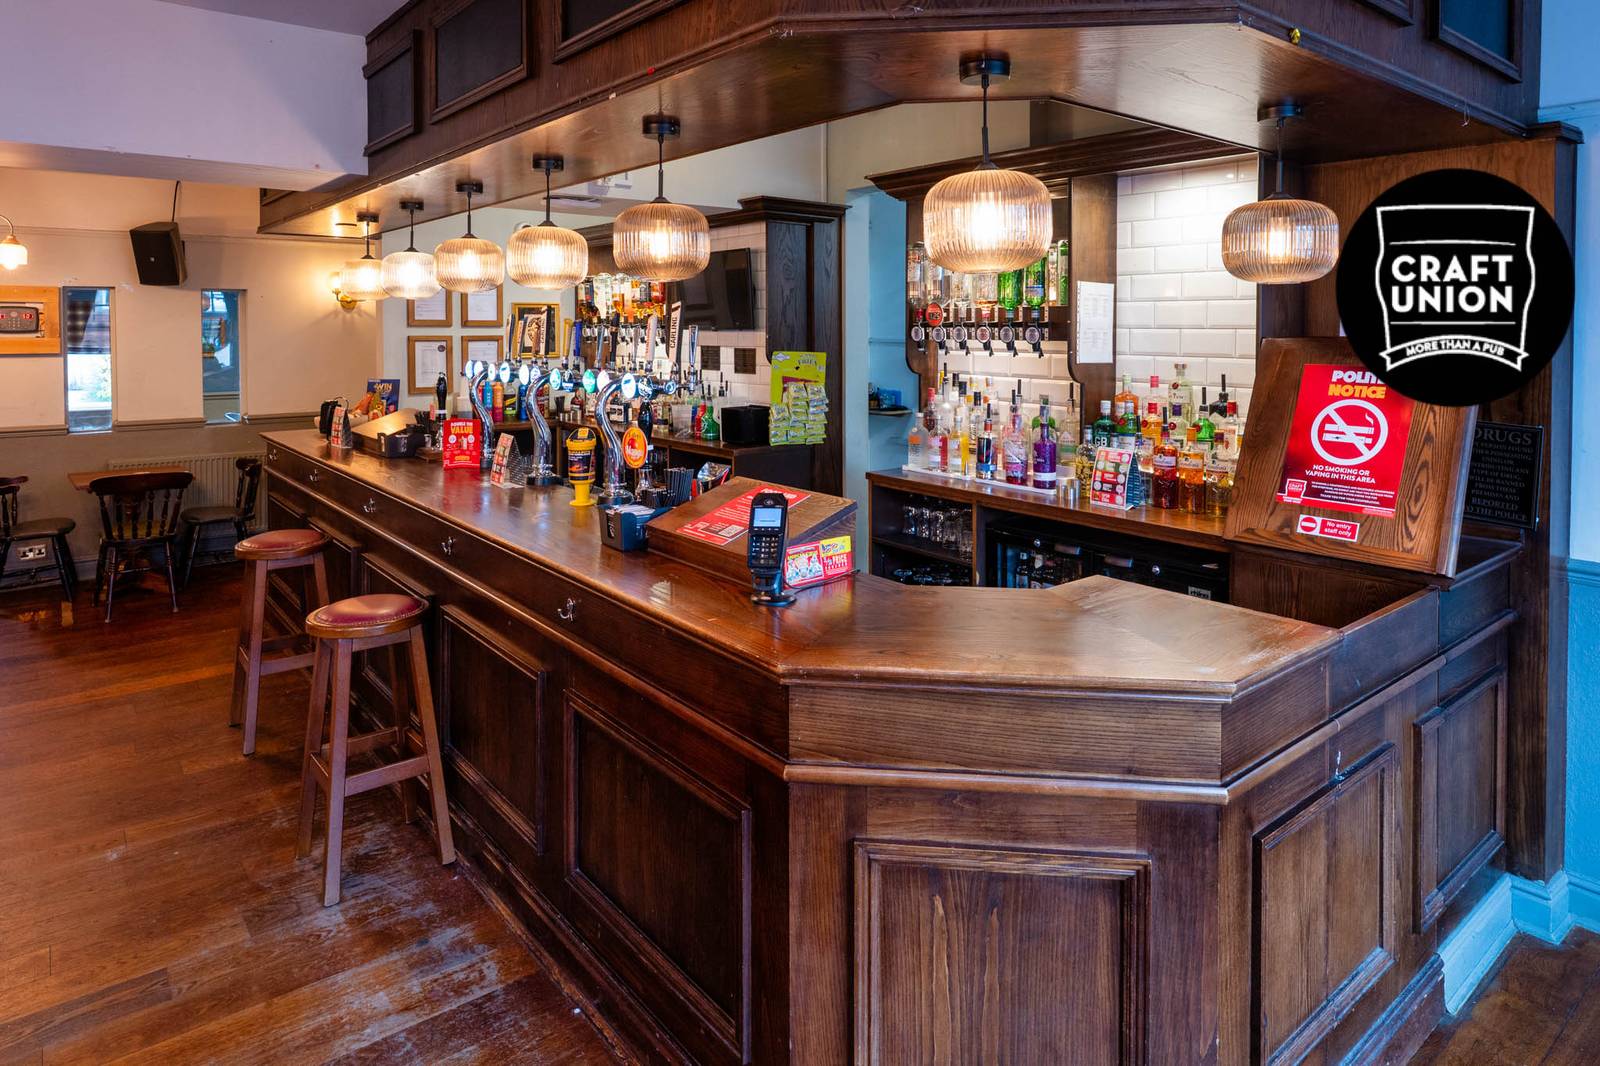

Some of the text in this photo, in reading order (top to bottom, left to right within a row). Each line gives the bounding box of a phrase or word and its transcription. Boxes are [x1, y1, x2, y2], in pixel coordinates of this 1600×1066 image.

[669, 316, 678, 348] CARLING
[1328, 384, 1386, 399] NOTICE
[450, 426, 474, 434] VALUE
[1325, 466, 1358, 475] SMOKING
[1305, 470, 1330, 478] VAPING
[1340, 474, 1356, 482] THIS
[1356, 476, 1376, 484] AREA
[1334, 522, 1352, 530] entry
